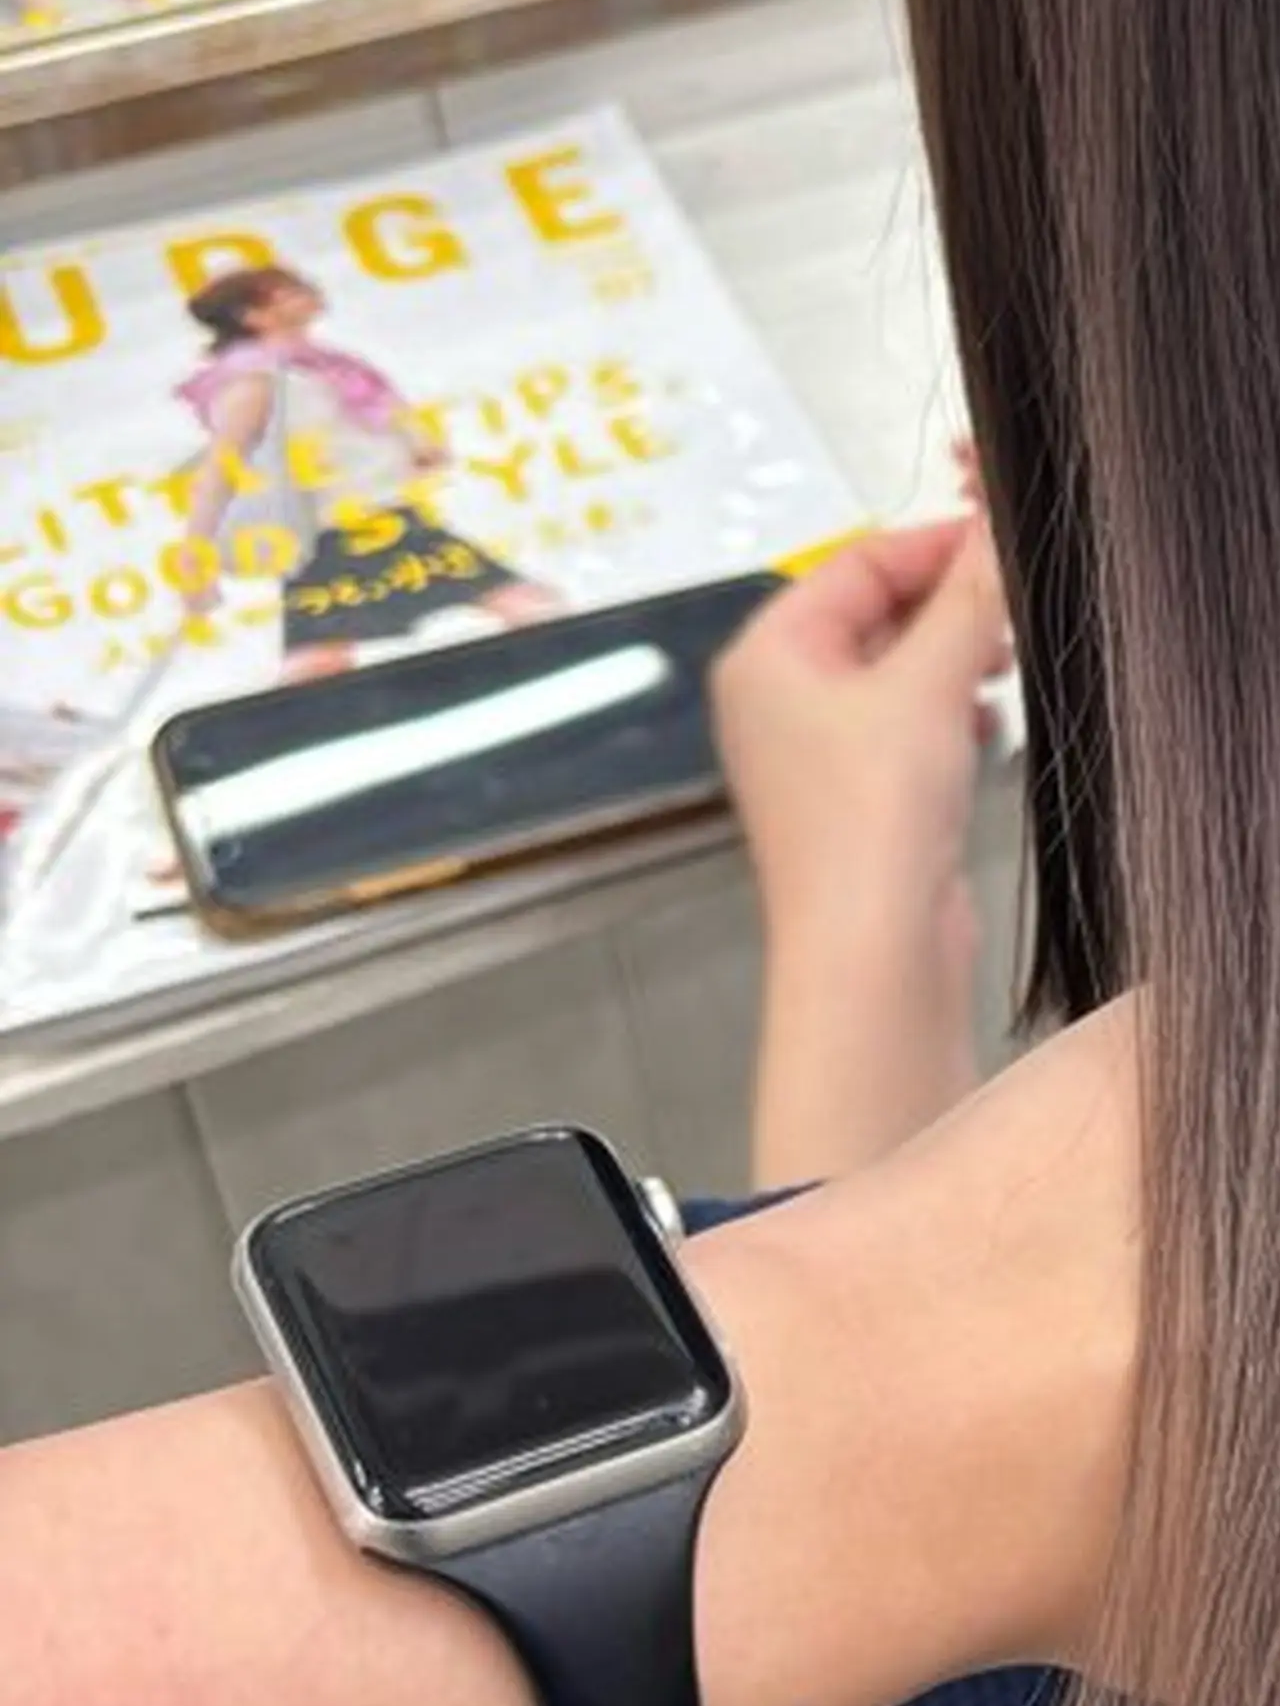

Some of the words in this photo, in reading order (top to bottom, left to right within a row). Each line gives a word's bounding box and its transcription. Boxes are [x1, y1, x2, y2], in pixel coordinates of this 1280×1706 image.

[0, 431, 337, 563] ITTLE
[3, 523, 300, 629] GOOD
[330, 415, 668, 555] STYLE
